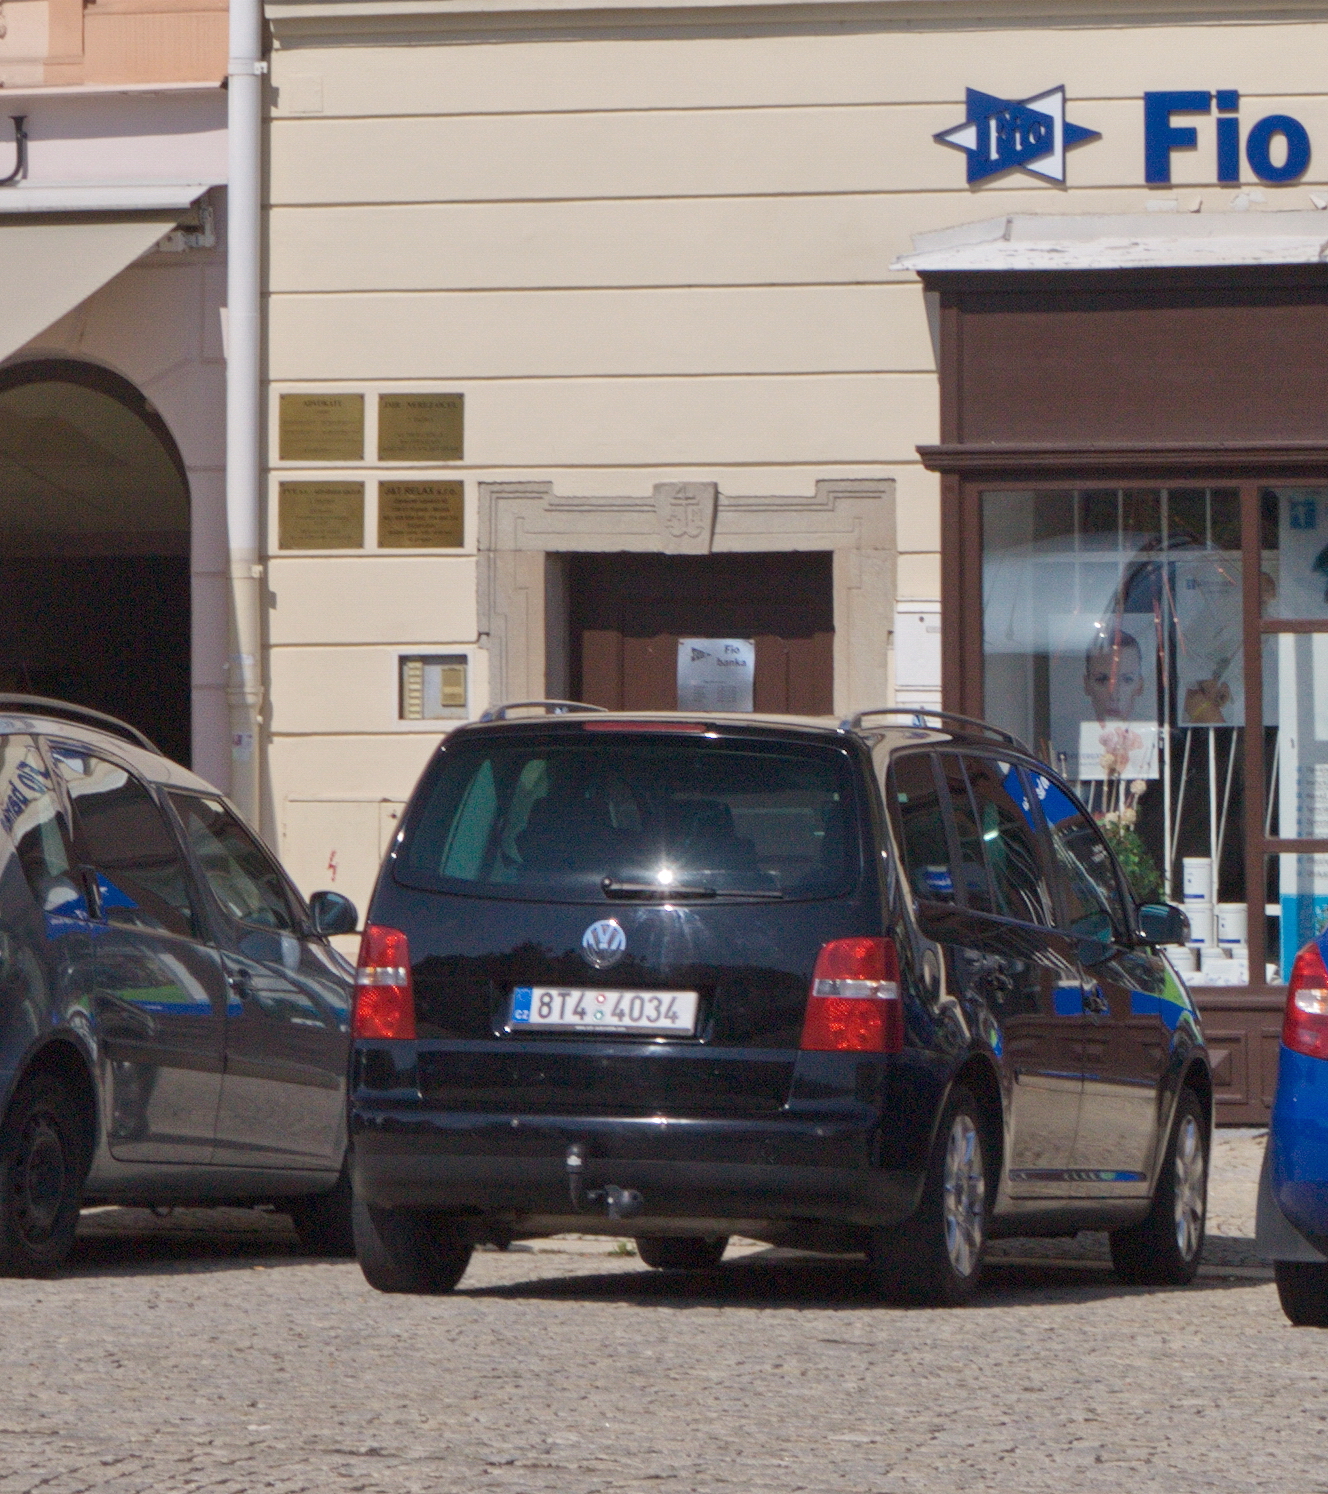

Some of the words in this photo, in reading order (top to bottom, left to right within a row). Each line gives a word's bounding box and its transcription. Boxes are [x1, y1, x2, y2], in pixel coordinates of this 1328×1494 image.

[1143, 90, 1312, 184] Fio
[537, 992, 587, 1021] 8T4
[611, 994, 679, 1024] 4034
